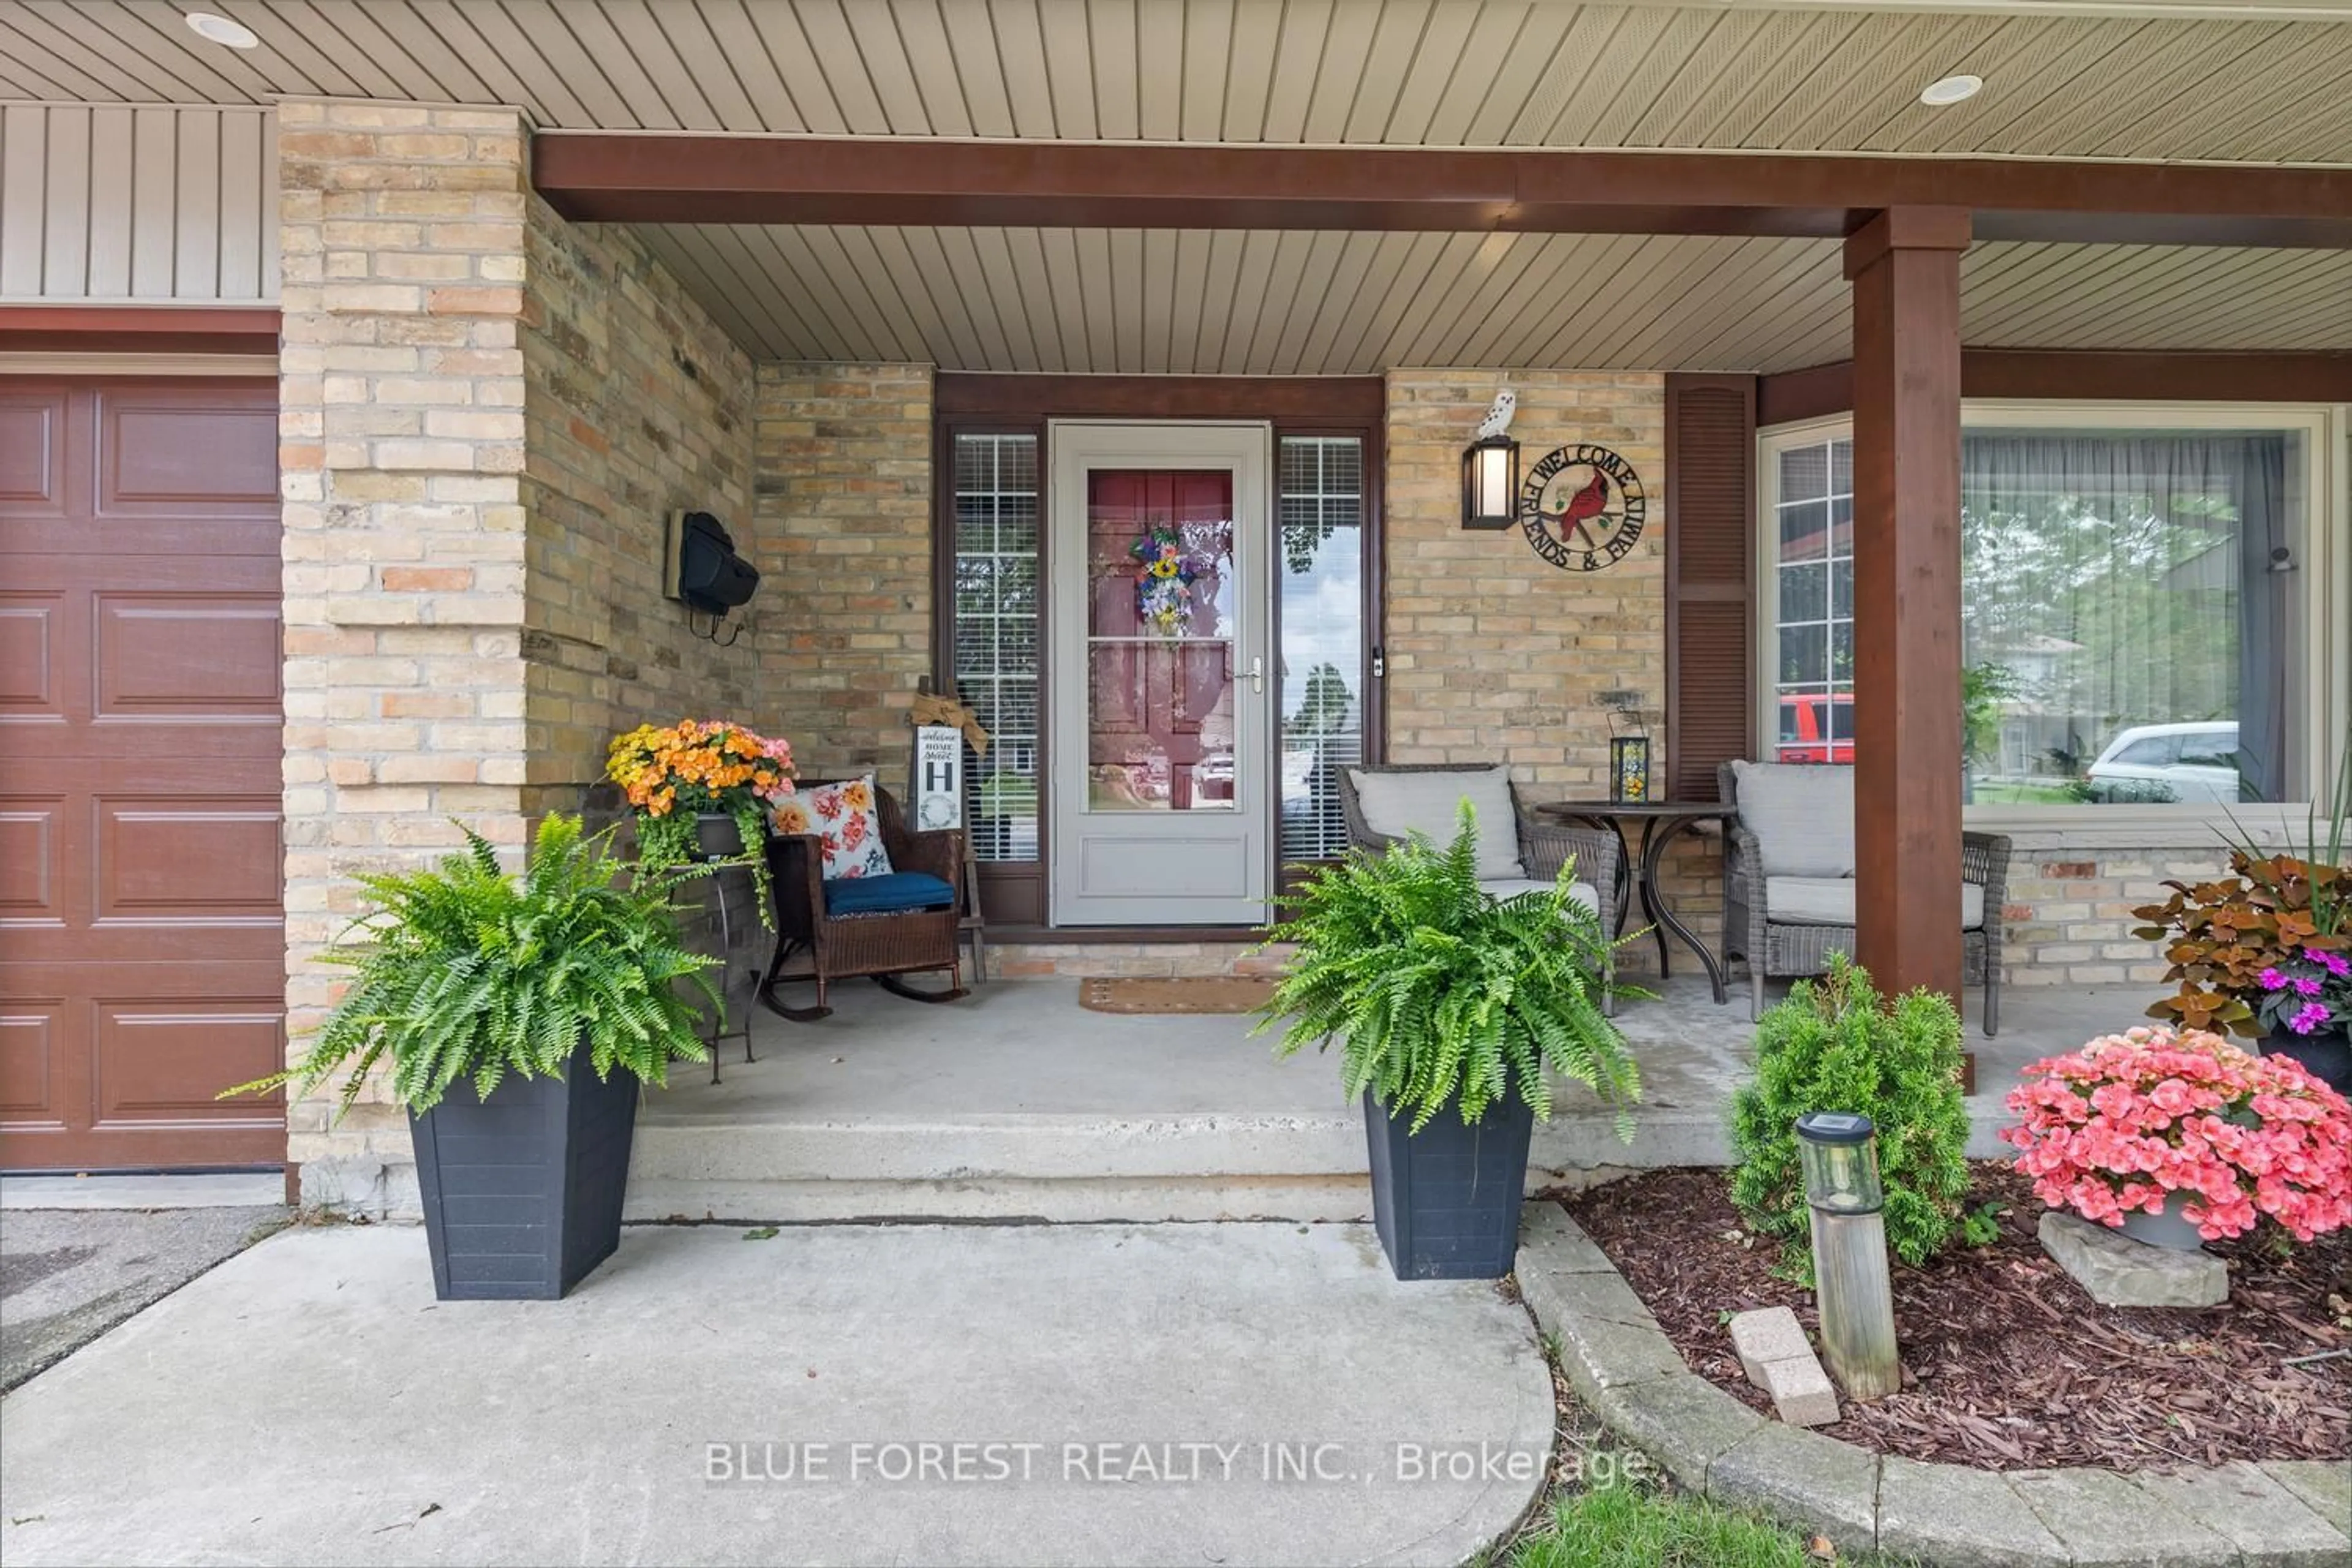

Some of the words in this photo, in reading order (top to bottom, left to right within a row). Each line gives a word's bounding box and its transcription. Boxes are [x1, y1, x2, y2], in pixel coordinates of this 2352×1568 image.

[1533, 445, 1636, 488] WELCOME
[1522, 482, 1570, 567] FRIENDS
[1583, 551, 1600, 570] &
[1606, 495, 1644, 561] FAMILY
[927, 762, 952, 791] H
